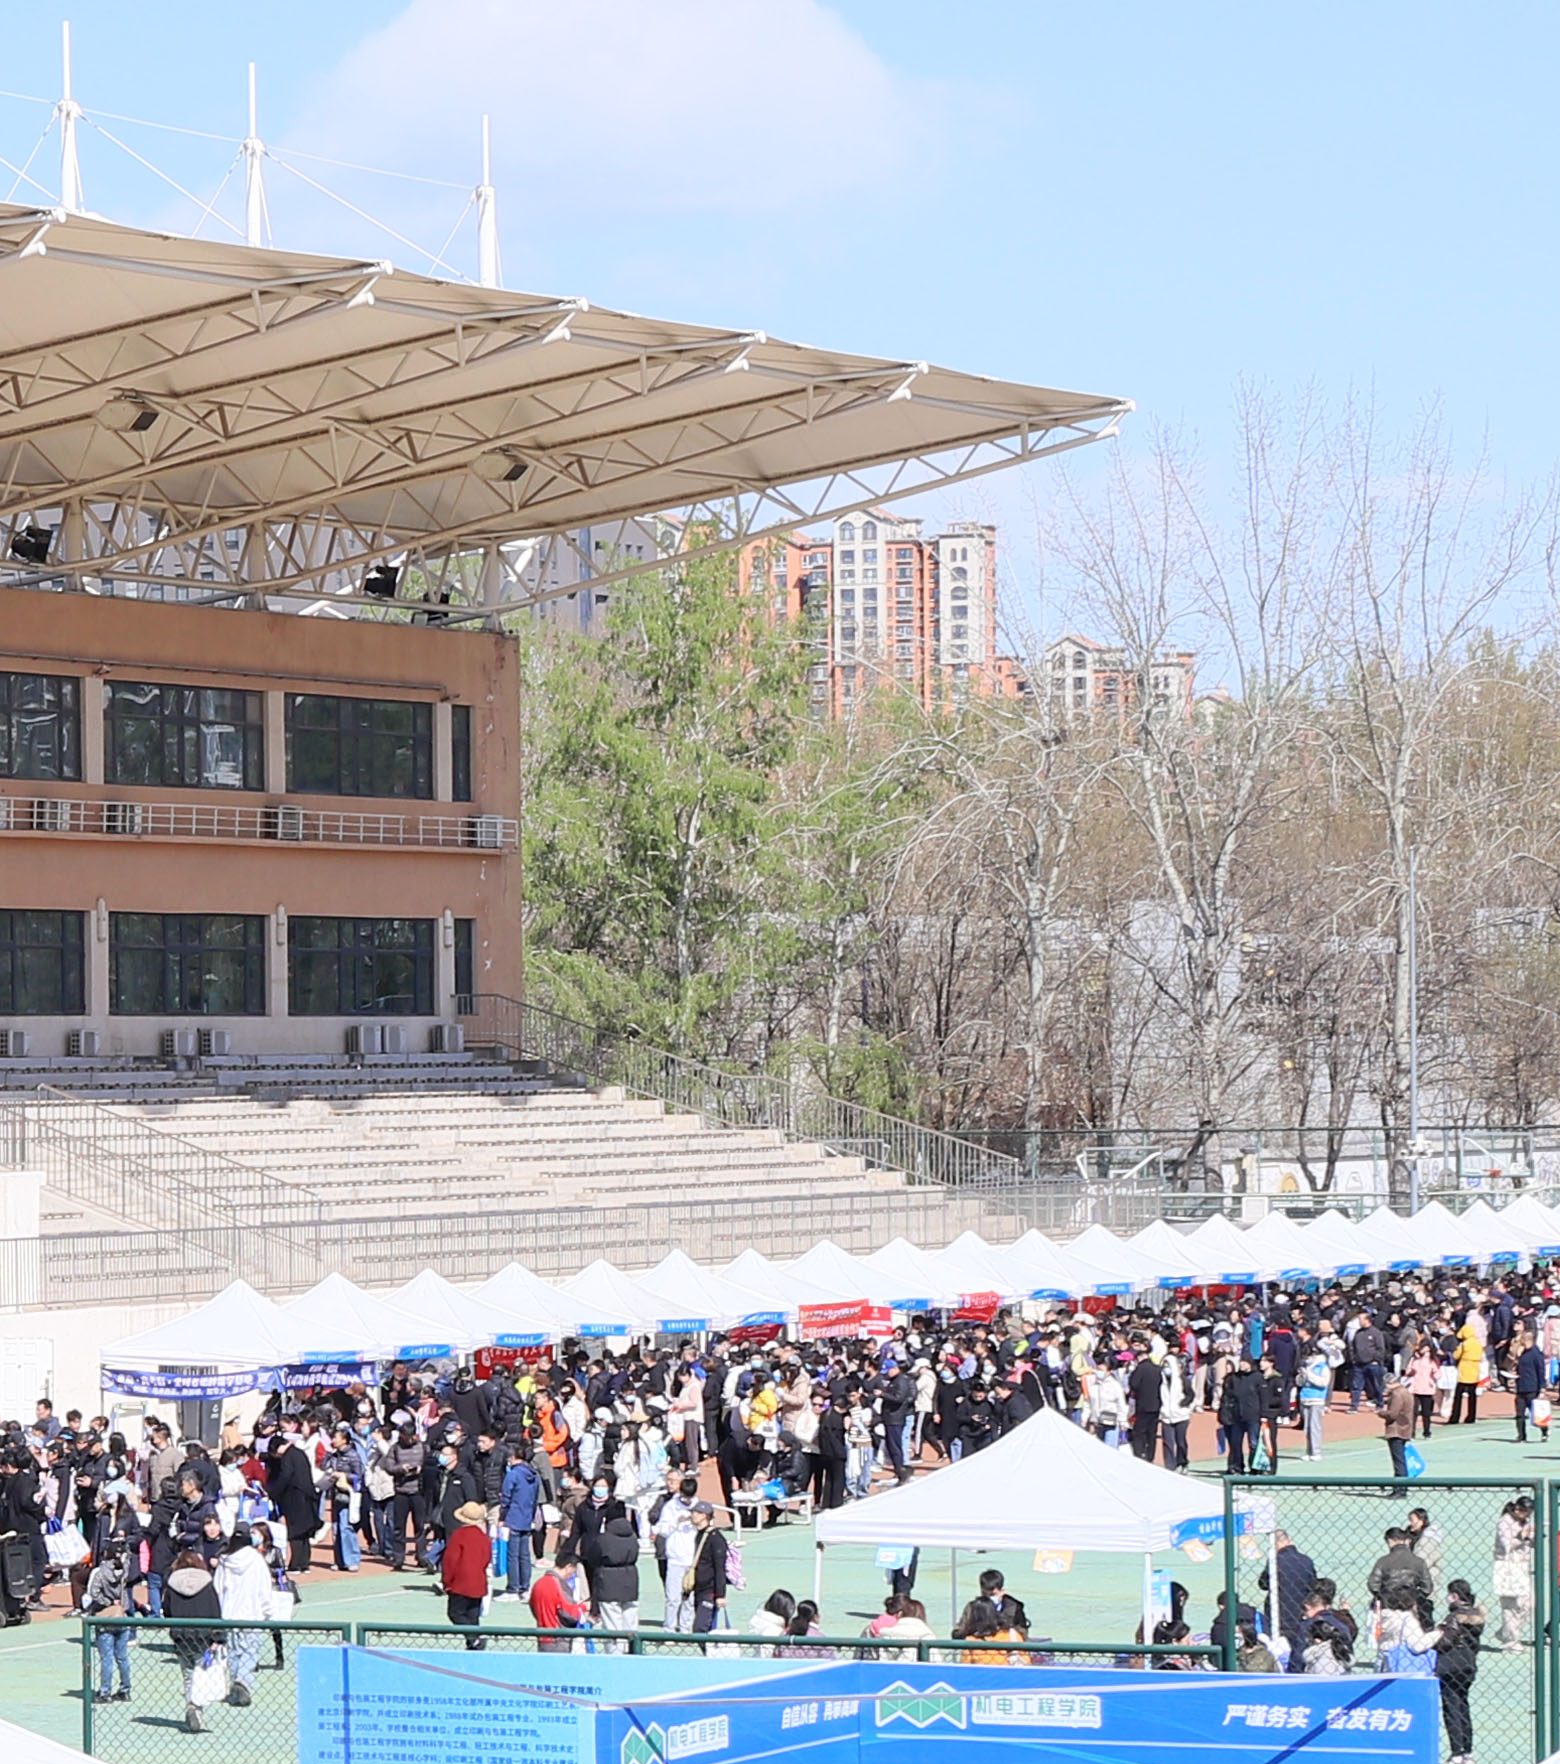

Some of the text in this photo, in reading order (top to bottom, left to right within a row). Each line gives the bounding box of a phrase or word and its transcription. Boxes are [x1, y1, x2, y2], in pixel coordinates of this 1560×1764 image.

[974, 1696, 1098, 1718] 机电工程学院
[1222, 1704, 1413, 1731] 严谨务实 奋发有为
